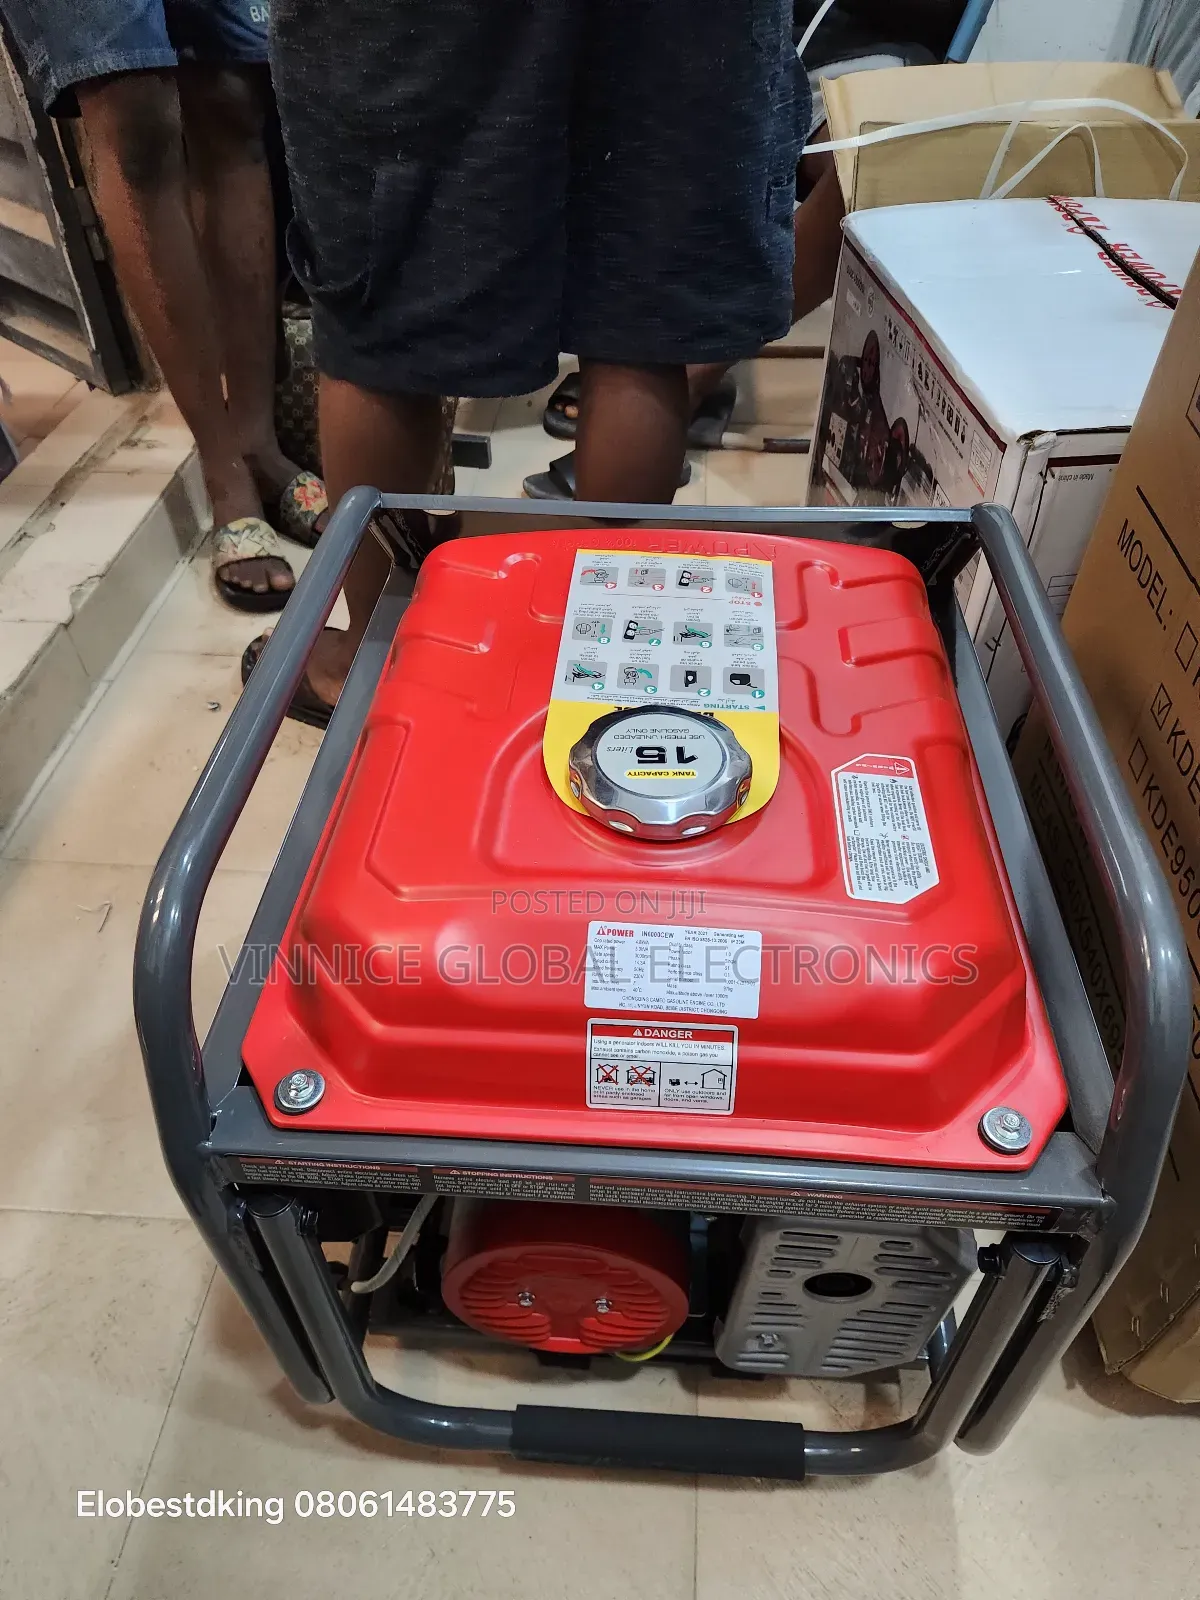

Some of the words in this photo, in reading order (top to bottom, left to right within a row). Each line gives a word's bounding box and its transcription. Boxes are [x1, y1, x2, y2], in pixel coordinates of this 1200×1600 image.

[1117, 517, 1172, 631] MODEL:
[636, 746, 698, 764] 15
[606, 929, 634, 938] POWER
[644, 1028, 692, 1039] DANGER
